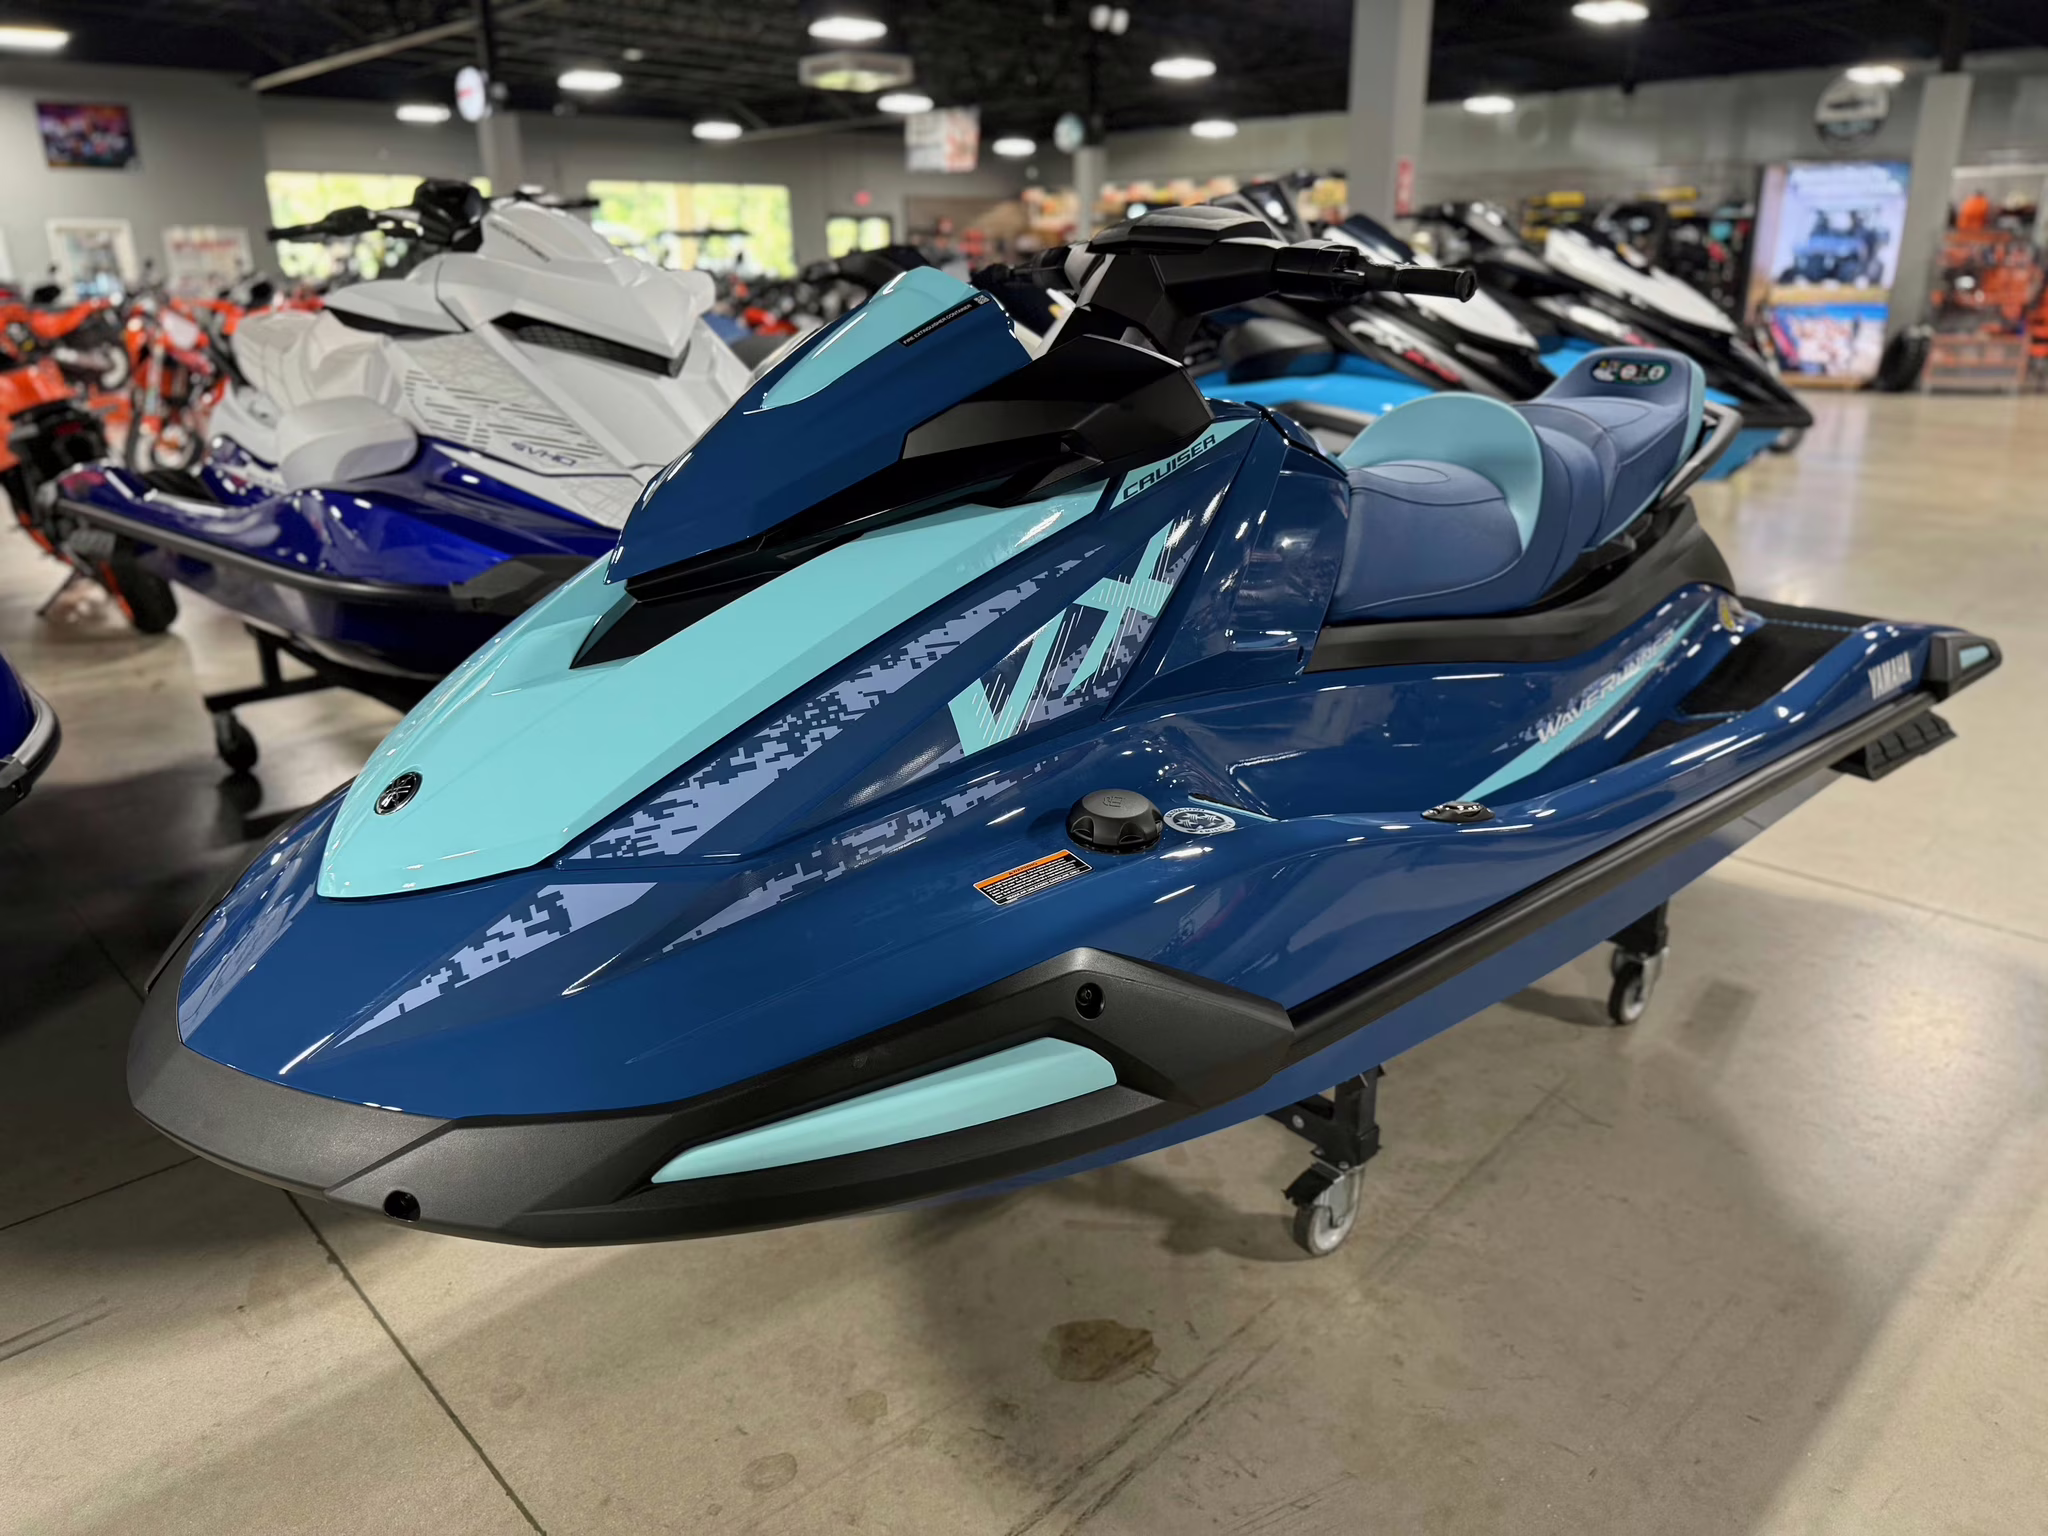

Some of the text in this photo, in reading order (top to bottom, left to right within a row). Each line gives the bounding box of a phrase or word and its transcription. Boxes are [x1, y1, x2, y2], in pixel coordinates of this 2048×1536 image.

[902, 304, 973, 344] FIRE EXTINGUISHER CONTAINER
[512, 442, 577, 466] SVHO
[1123, 434, 1216, 500] CRUISER
[948, 518, 1175, 757] VX
[1868, 650, 1912, 700] YAMAHA
[1013, 862, 1038, 874] WARNING
